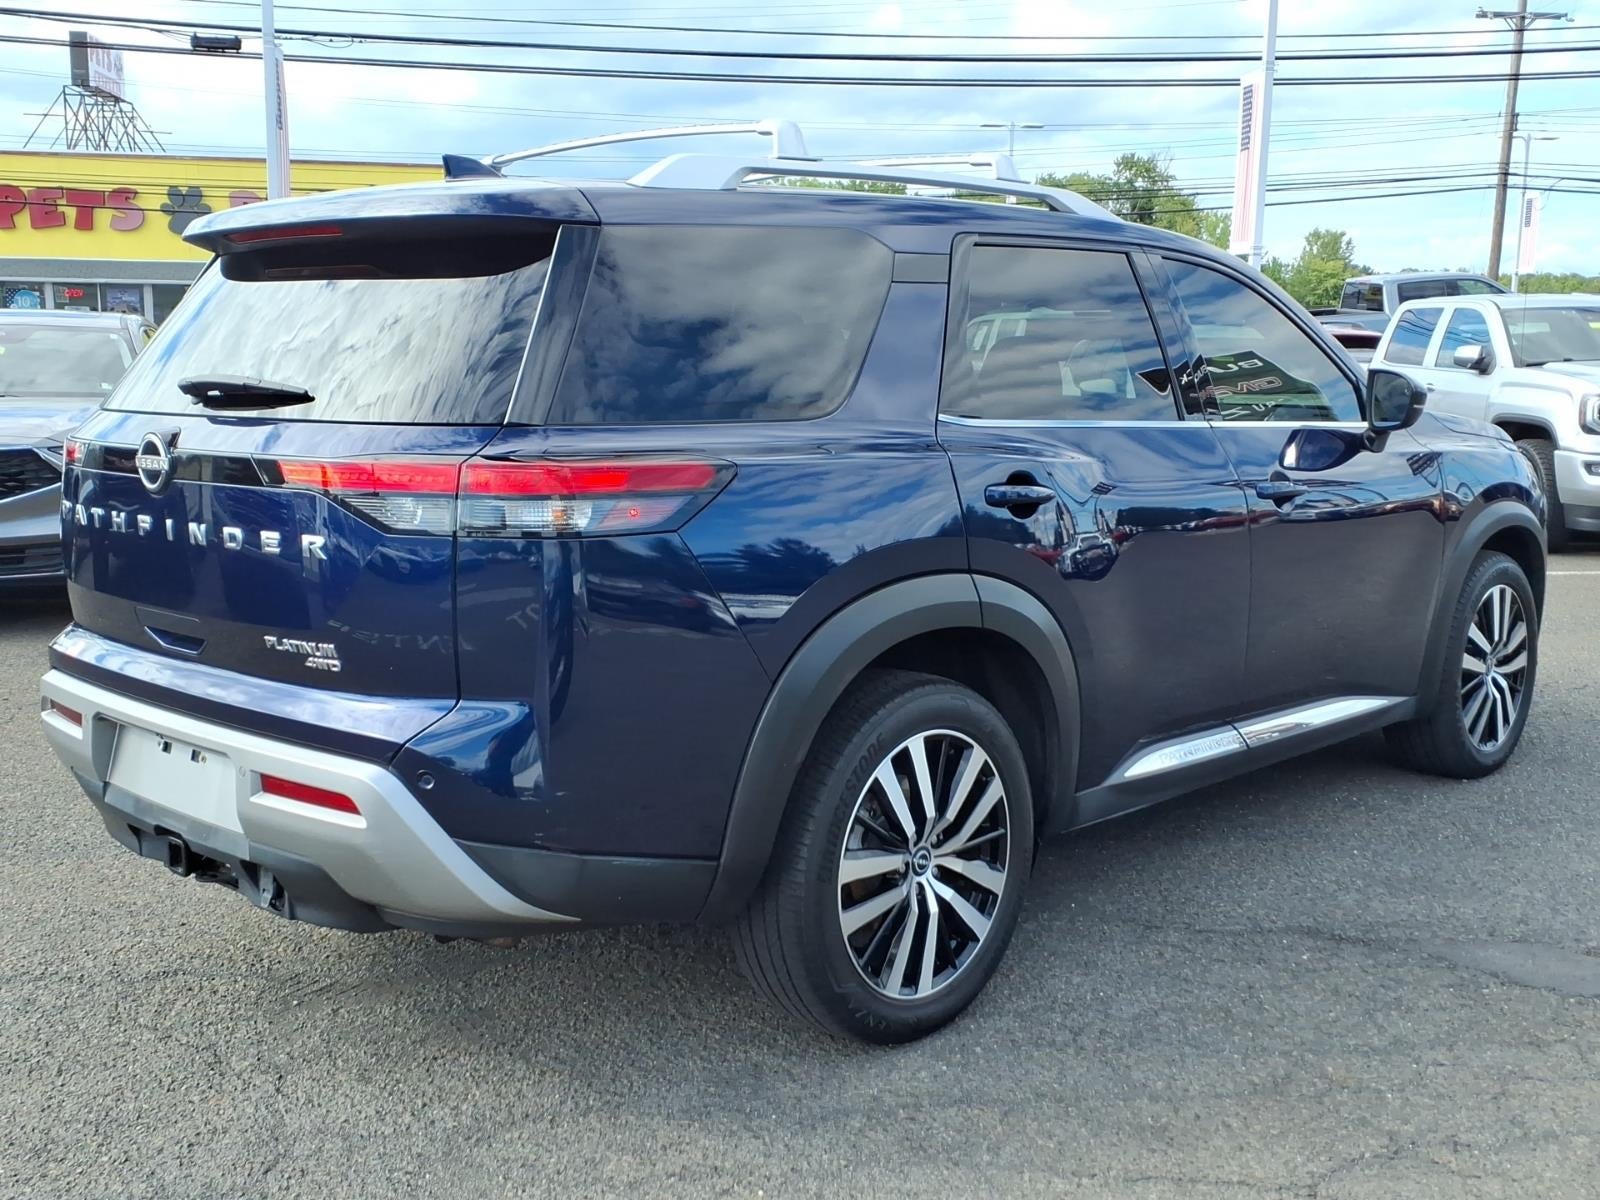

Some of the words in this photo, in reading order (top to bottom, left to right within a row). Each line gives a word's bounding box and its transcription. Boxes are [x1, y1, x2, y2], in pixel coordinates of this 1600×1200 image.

[0, 184, 145, 231] PETS
[64, 288, 84, 298] OPEN
[136, 456, 169, 471] SSAN
[62, 500, 328, 560] PATHFINDER
[263, 635, 339, 658] PLATINUM
[304, 657, 342, 672] 4WD
